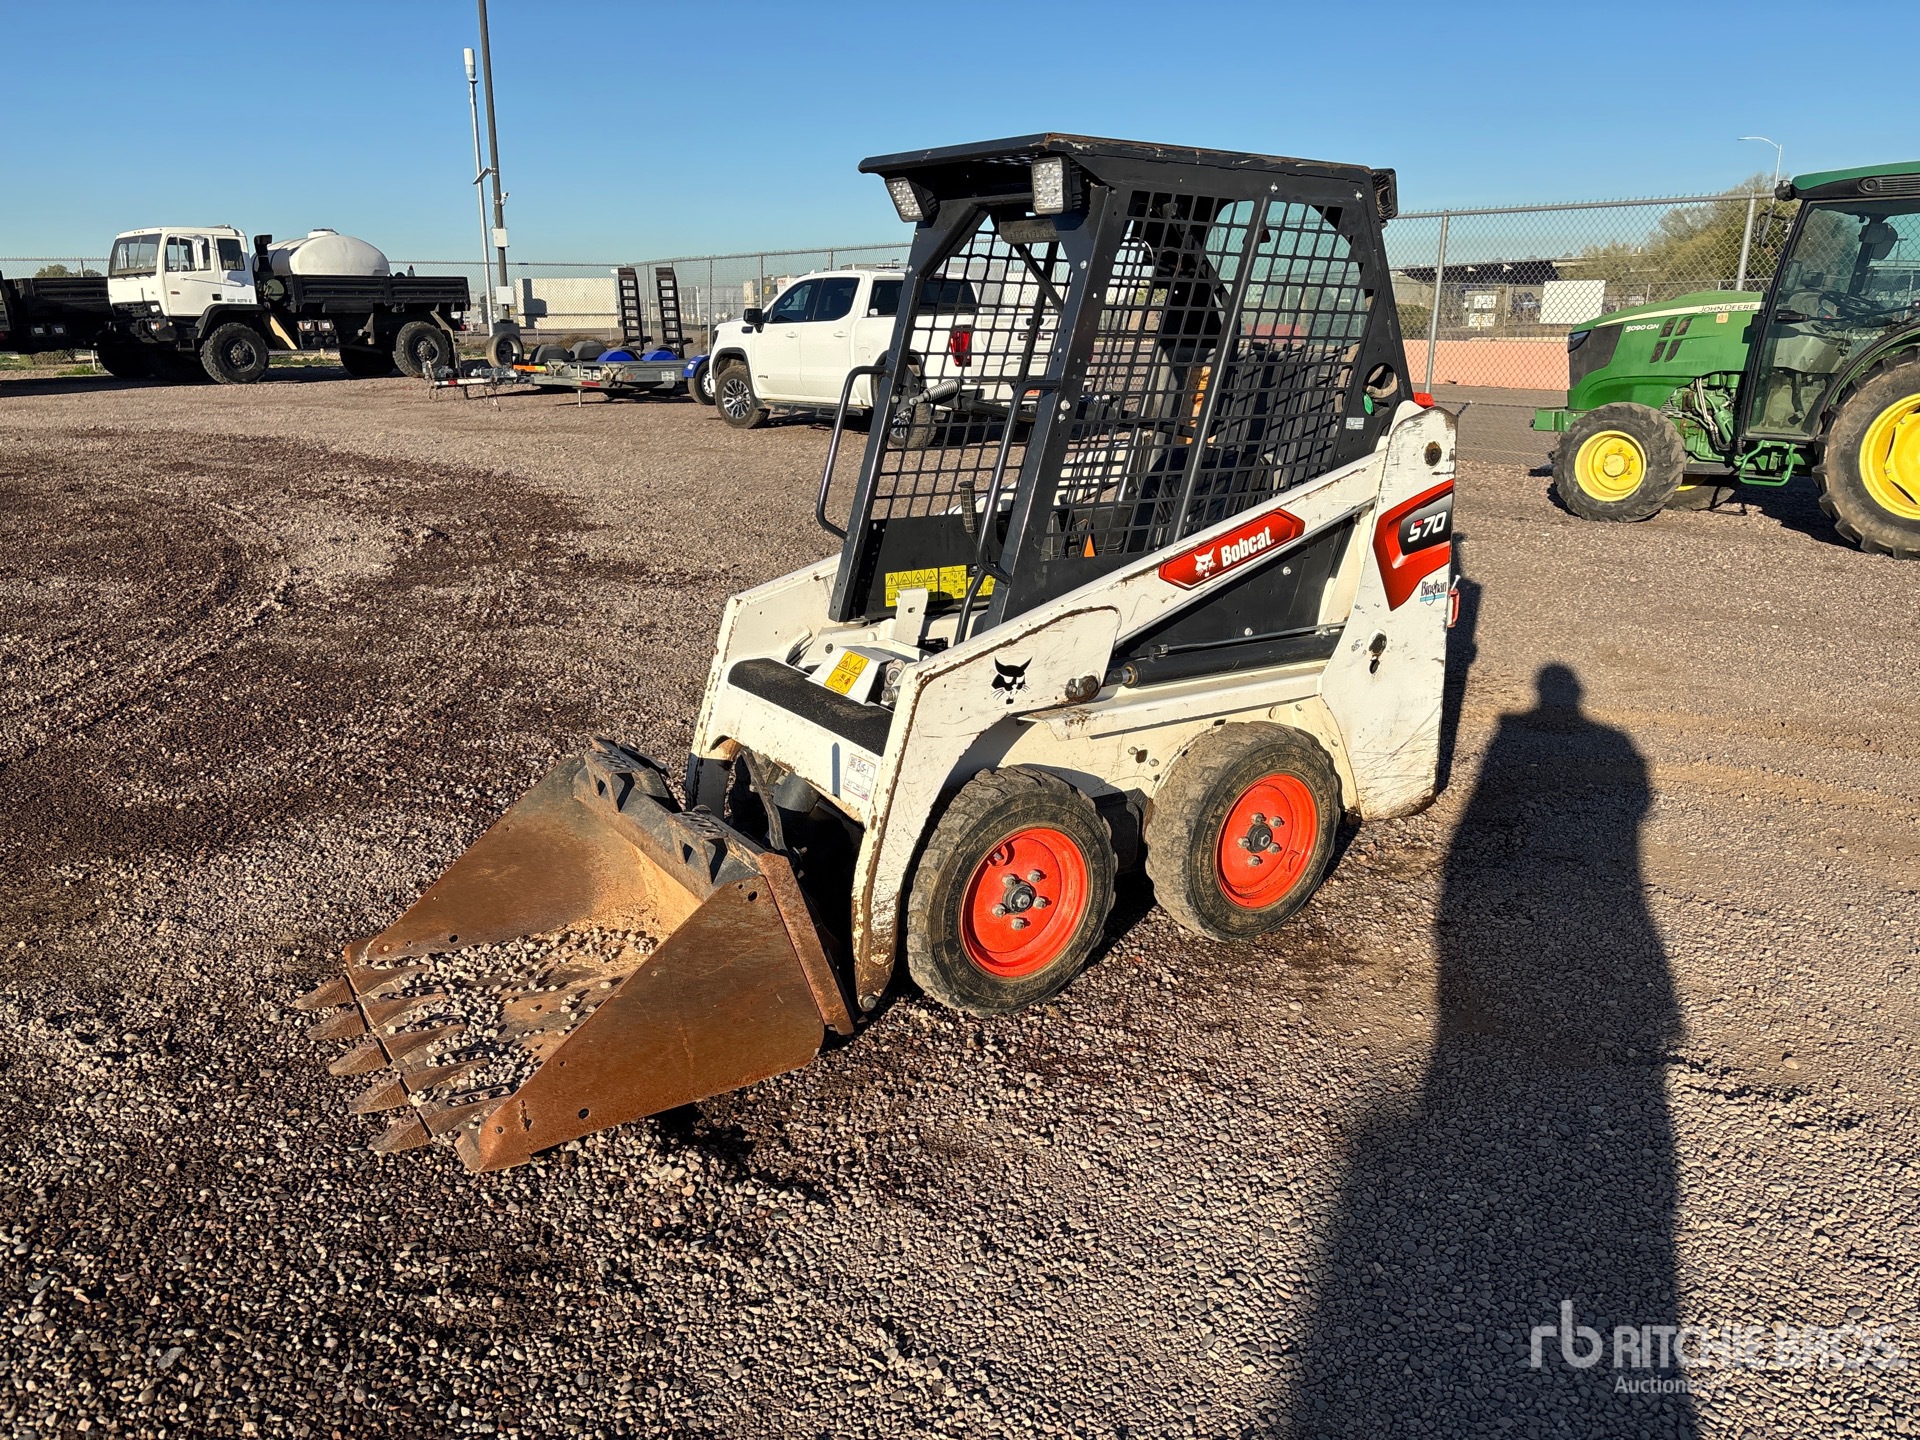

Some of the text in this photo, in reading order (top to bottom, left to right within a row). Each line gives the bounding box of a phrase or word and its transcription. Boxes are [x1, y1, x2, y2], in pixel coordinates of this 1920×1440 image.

[1699, 303, 1756, 313] JOHN DEERE
[1625, 324, 1646, 333] 5090
[1407, 510, 1447, 543] S70
[1220, 526, 1272, 568] Bobcat
